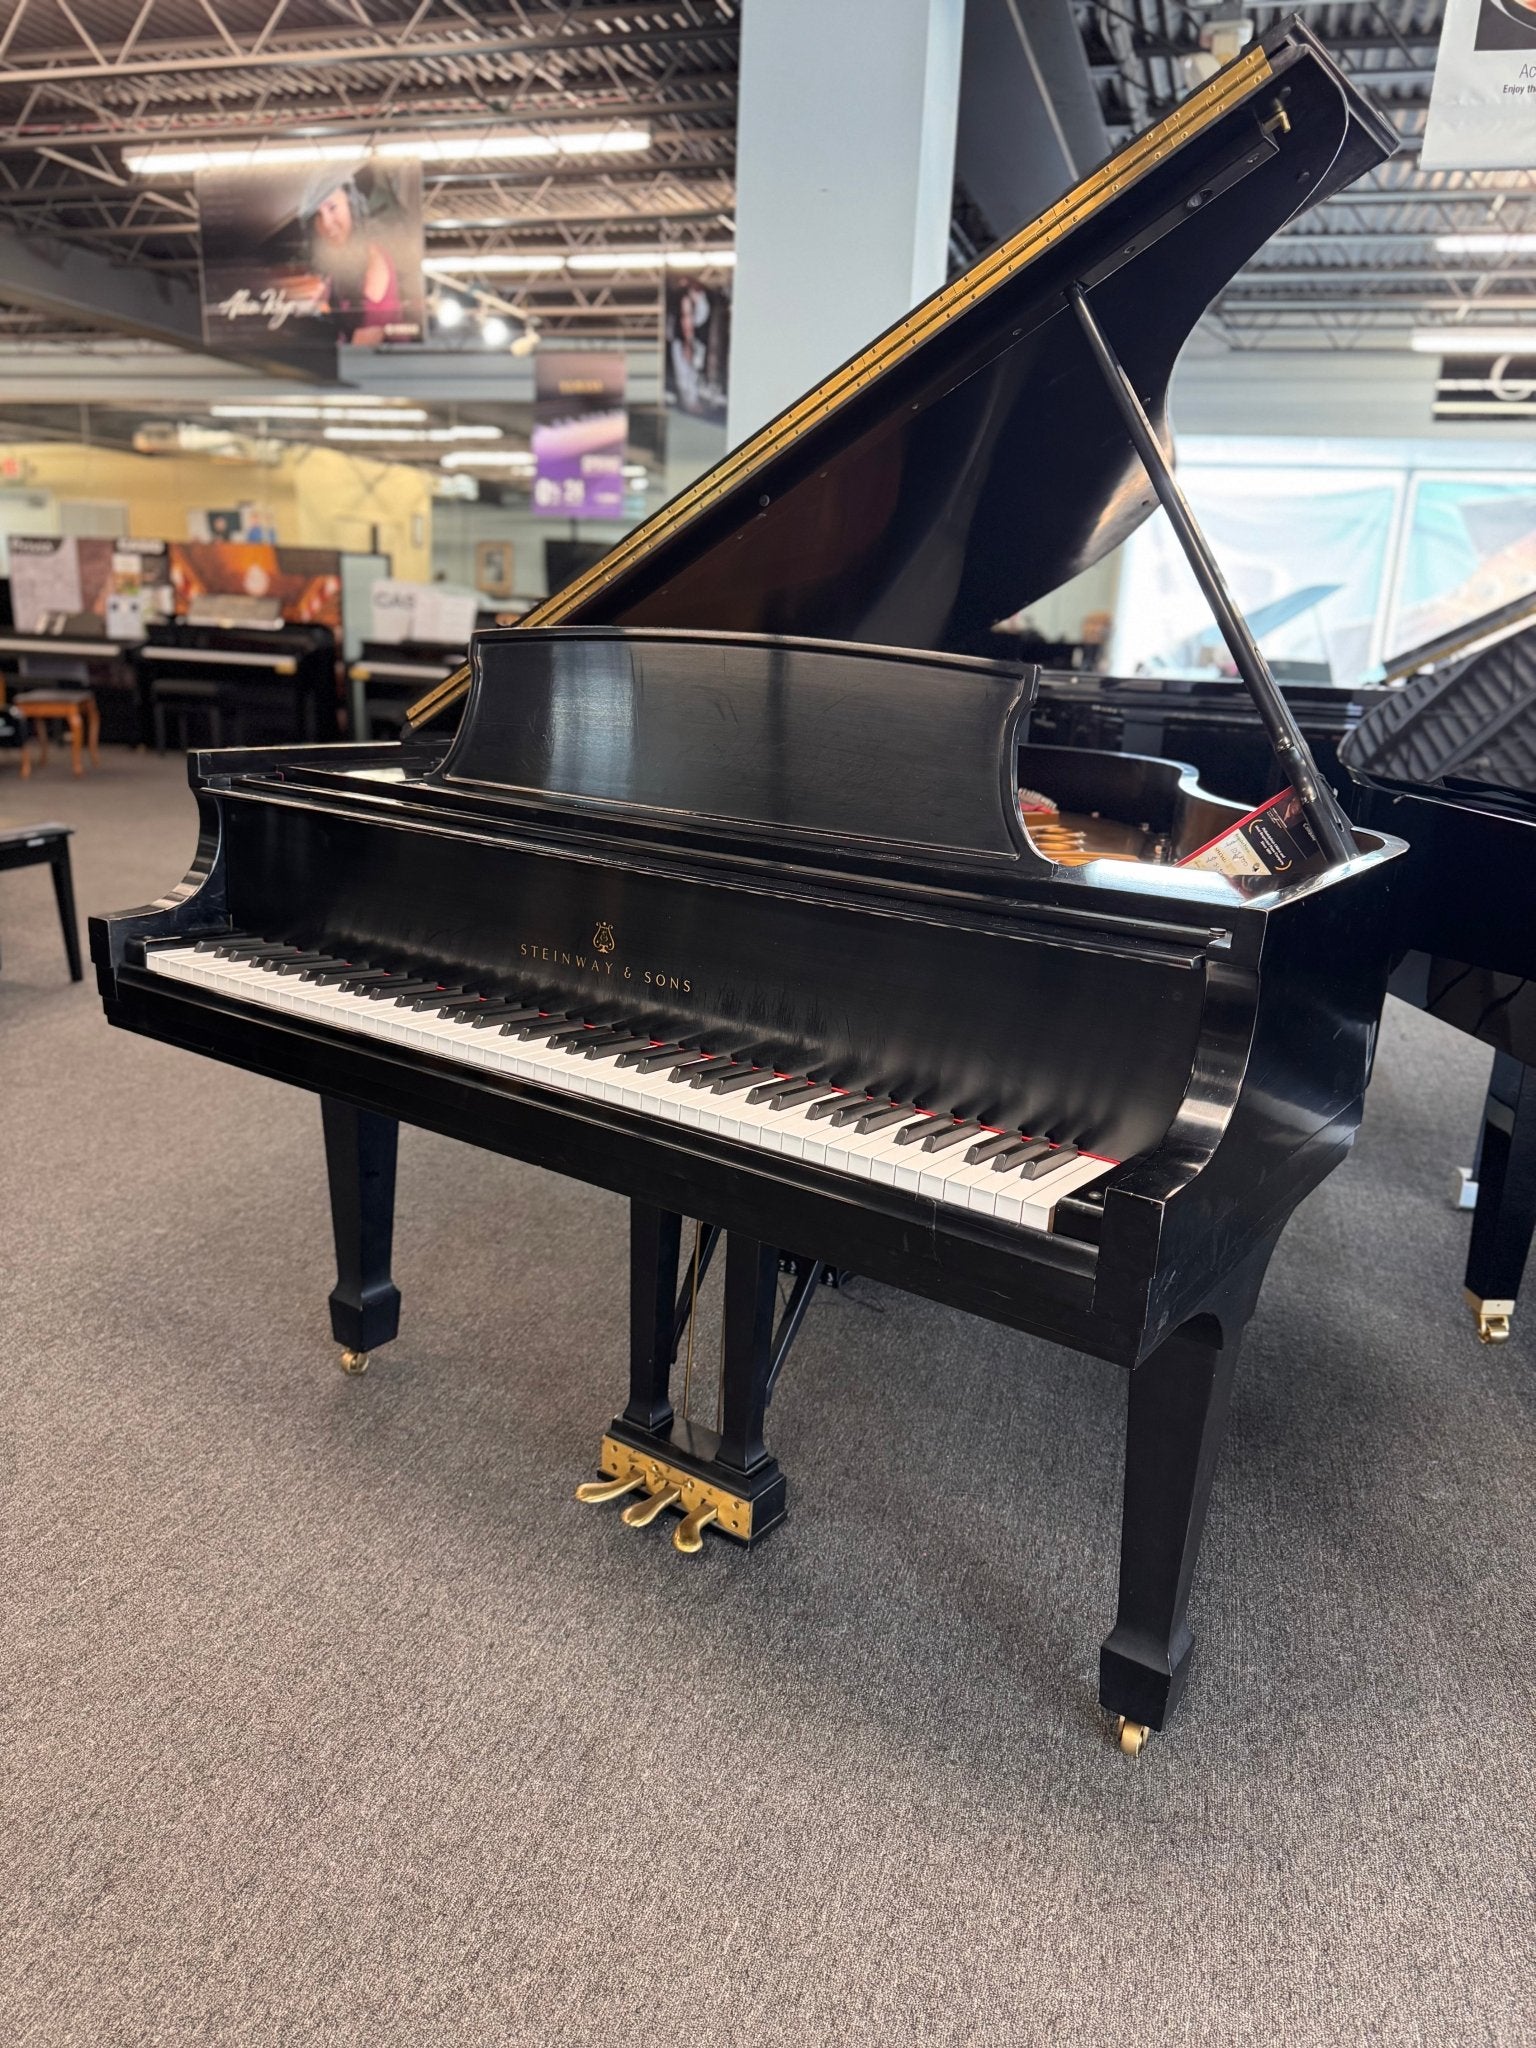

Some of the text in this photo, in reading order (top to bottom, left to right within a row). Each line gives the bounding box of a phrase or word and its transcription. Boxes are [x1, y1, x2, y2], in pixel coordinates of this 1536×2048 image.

[1502, 84, 1525, 95] Enjoy
[520, 943, 691, 993] STEINWAY & SONS
